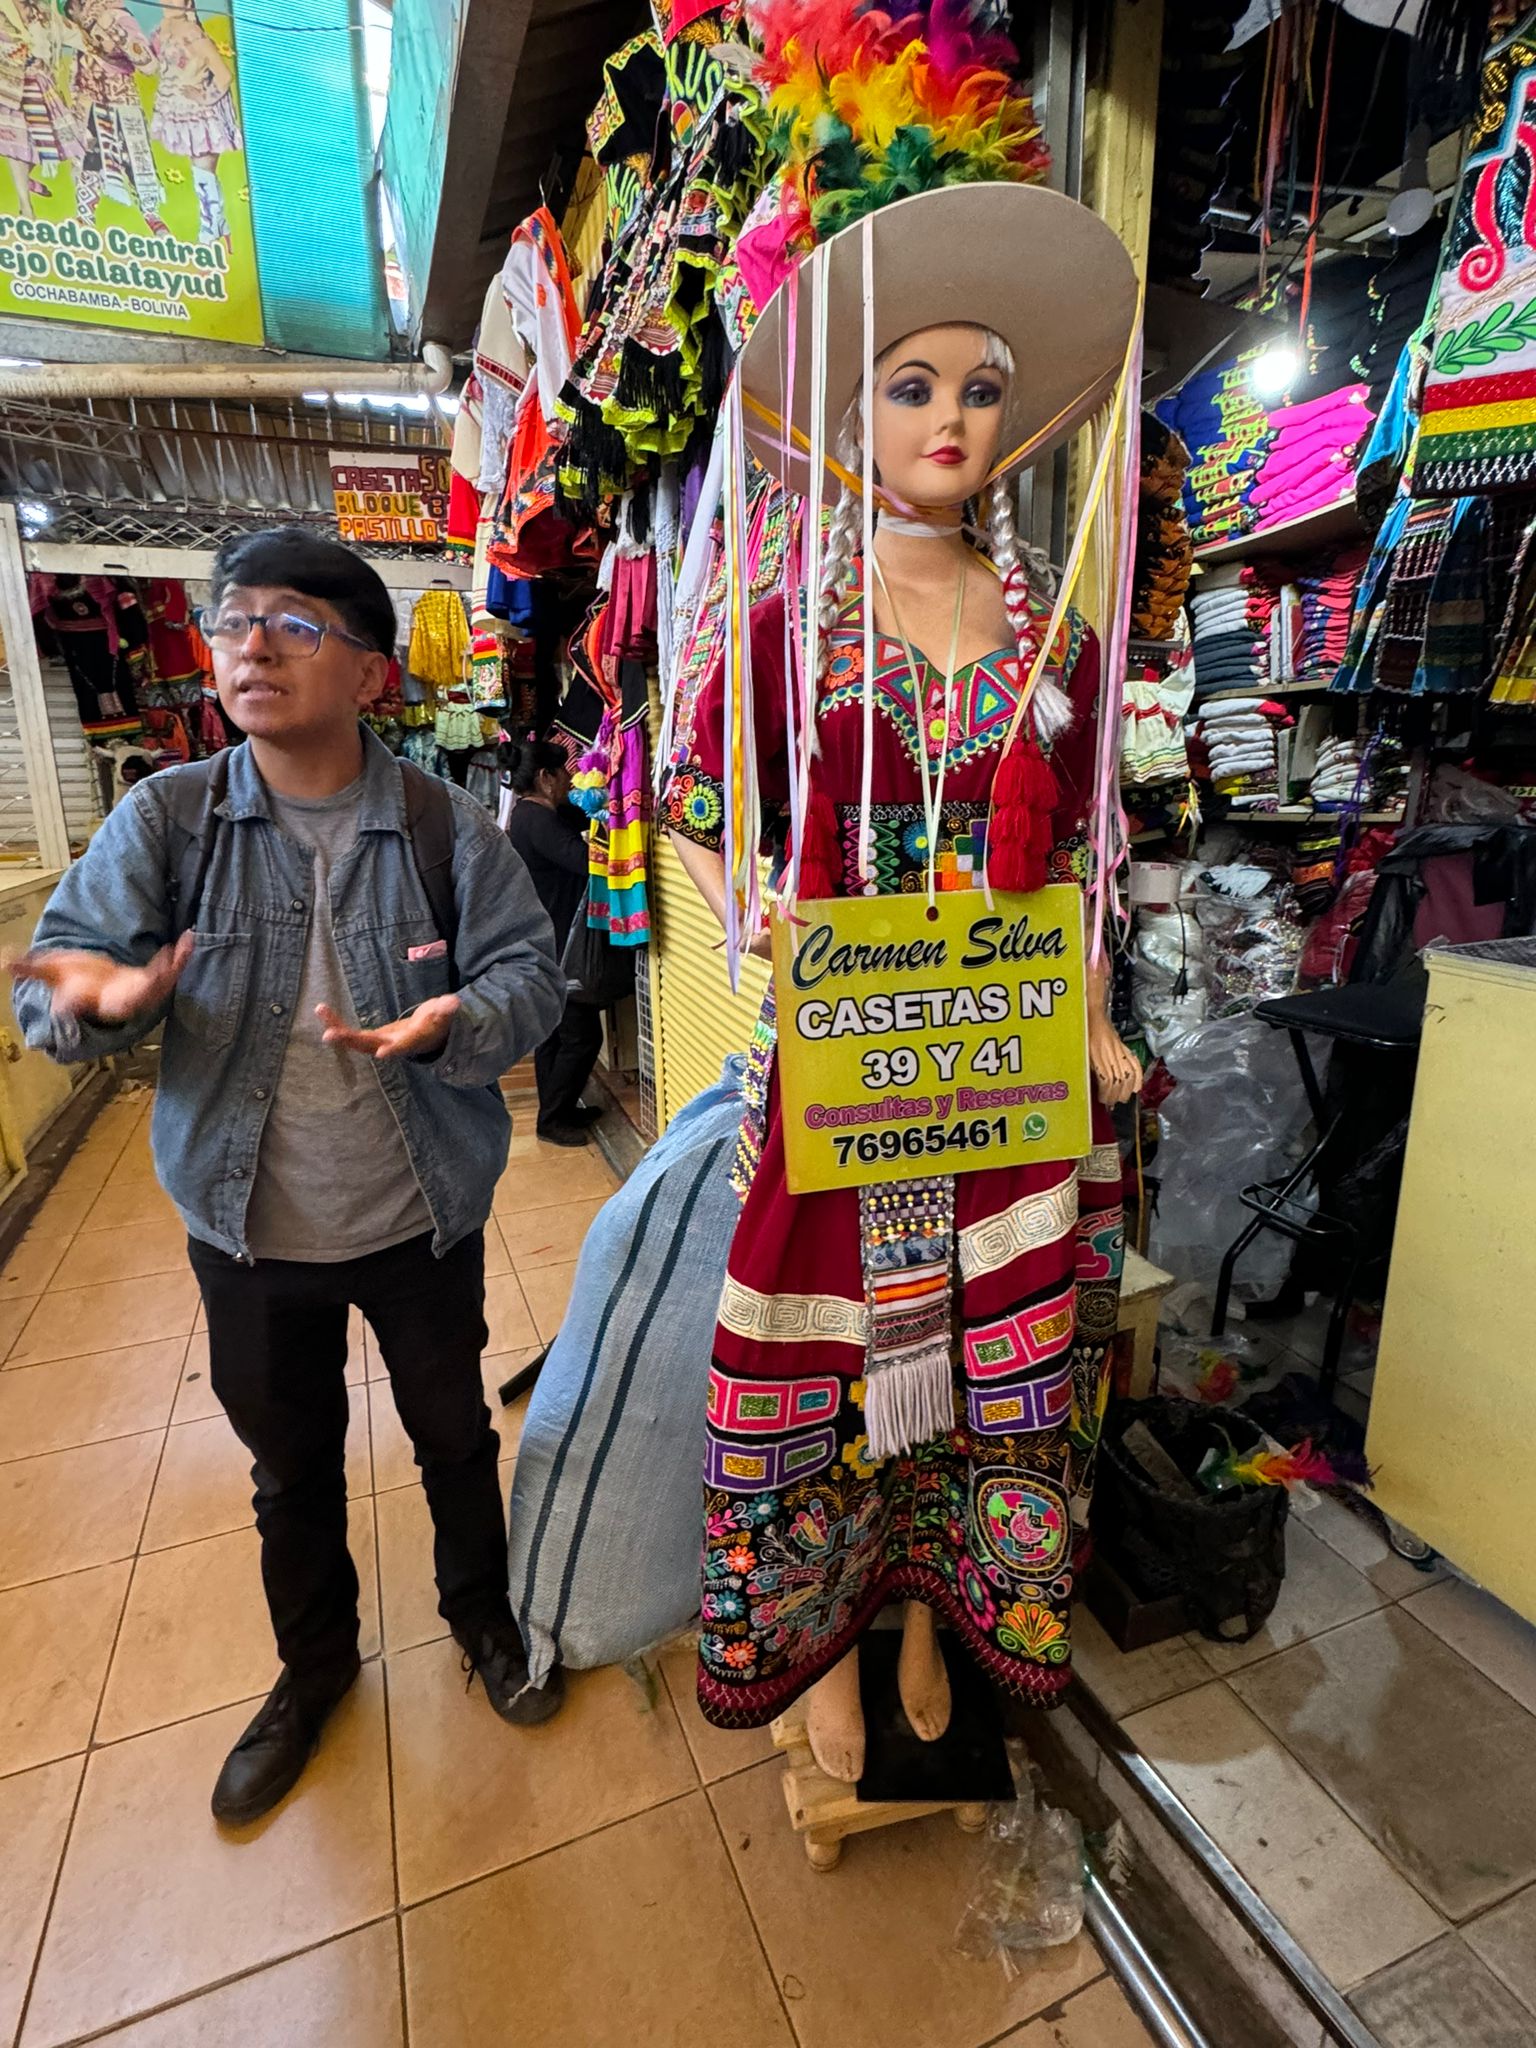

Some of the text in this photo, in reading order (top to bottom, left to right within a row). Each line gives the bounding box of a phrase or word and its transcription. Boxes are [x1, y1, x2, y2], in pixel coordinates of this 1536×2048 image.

[108, 228, 227, 270] Central
[56, 251, 226, 298] Calatayud
[332, 455, 450, 494] CASETA 50
[338, 517, 438, 542] PASILLO
[791, 914, 1067, 990] Carmen Silva
[796, 978, 1067, 1040] CASETAS N°
[861, 1036, 1022, 1089] 39 Y 41
[805, 1081, 1069, 1130] Consultas y Reservas
[832, 1116, 1008, 1167] 76965461
